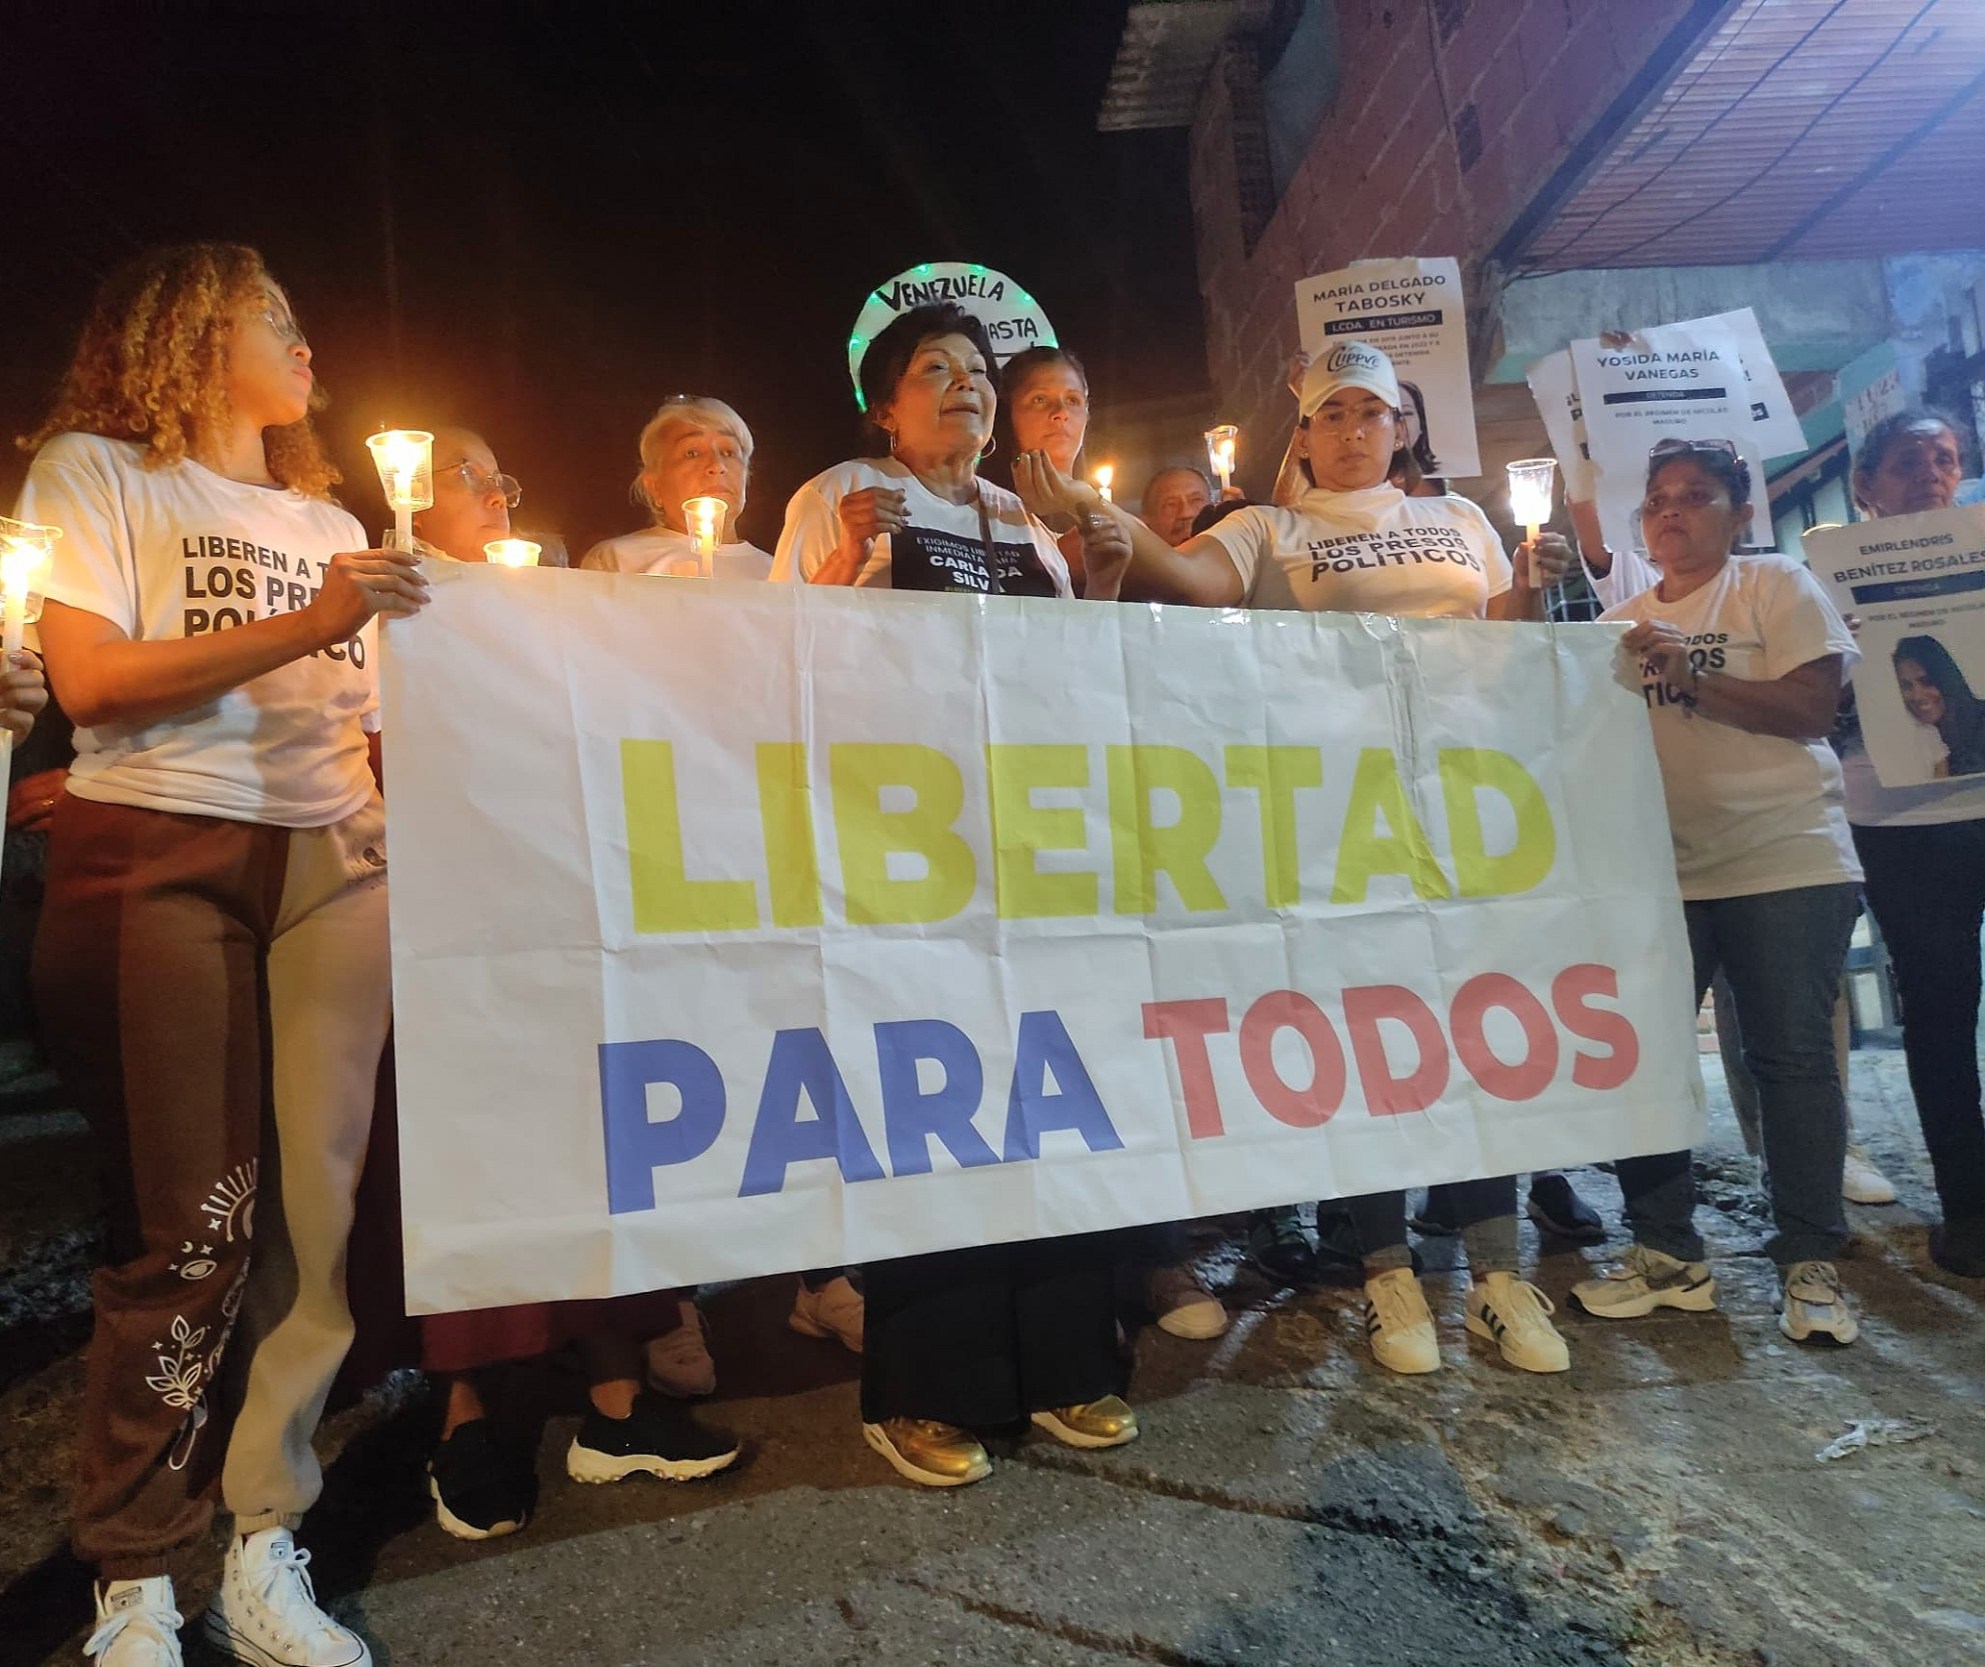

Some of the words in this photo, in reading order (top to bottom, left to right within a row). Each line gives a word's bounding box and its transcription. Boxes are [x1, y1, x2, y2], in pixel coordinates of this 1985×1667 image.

[876, 275, 1004, 311] VENEZUELA
[1313, 283, 1365, 302] MARÍA
[1369, 275, 1446, 292] DELGADO
[1335, 292, 1426, 313] TABOSKY
[984, 317, 1039, 340] ASTA
[1369, 319, 1385, 328] EN
[1387, 314, 1436, 327] TURISMO
[1597, 353, 1662, 368] YOSIDA
[1667, 348, 1720, 363] MARÍA
[1625, 368, 1700, 381] VANEGAS
[916, 535, 970, 553] EXIGIMOS
[1307, 532, 1382, 551] LIBEREN
[1388, 530, 1400, 539] A
[1403, 527, 1462, 538] TODOS
[1311, 545, 1360, 561] LOS
[1369, 537, 1470, 553] PRESOS
[1859, 534, 1954, 555] EMIRLENDRIS
[182, 535, 288, 573] LIBEREN
[296, 557, 311, 579] A
[925, 545, 985, 564] INMEDIATA
[1311, 548, 1482, 583] POLÍTICOS
[1833, 561, 1908, 583] BENÍTEZ
[1912, 550, 1985, 572] ROSALES
[929, 555, 991, 579] CARLA
[185, 566, 256, 599] LOS
[620, 738, 1557, 934] LIBERTAD
[597, 1010, 1126, 1215] PARA
[1141, 963, 1639, 1140] TODOS
